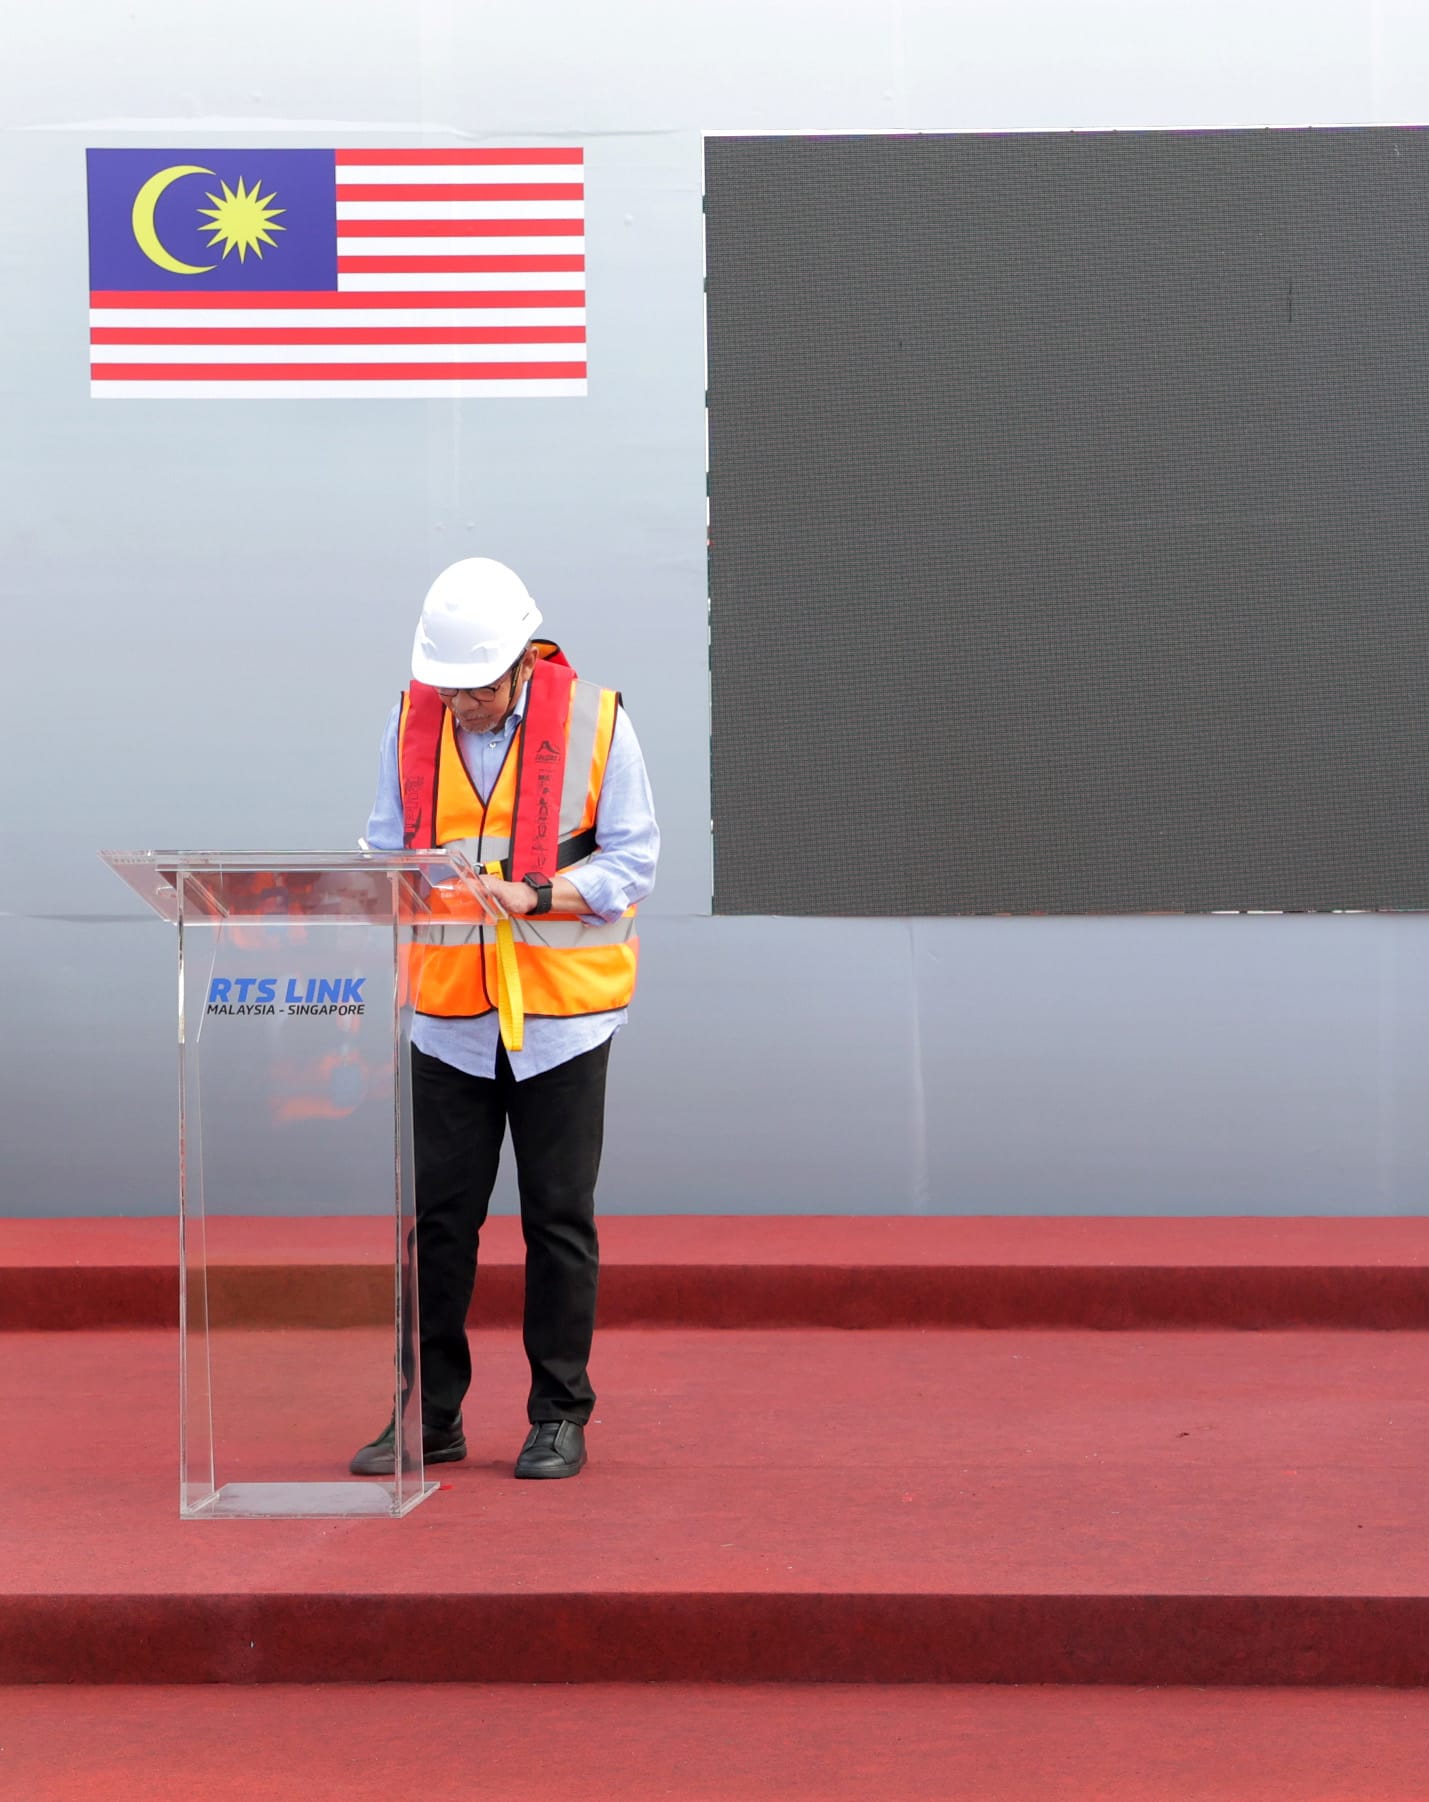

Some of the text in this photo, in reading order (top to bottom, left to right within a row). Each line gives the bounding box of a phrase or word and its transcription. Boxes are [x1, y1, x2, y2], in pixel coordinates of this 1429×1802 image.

[208, 978, 366, 1003] RTS LINK
[207, 1004, 275, 1015] MALAYSIA
[287, 1004, 366, 1016] SINGAPORE
